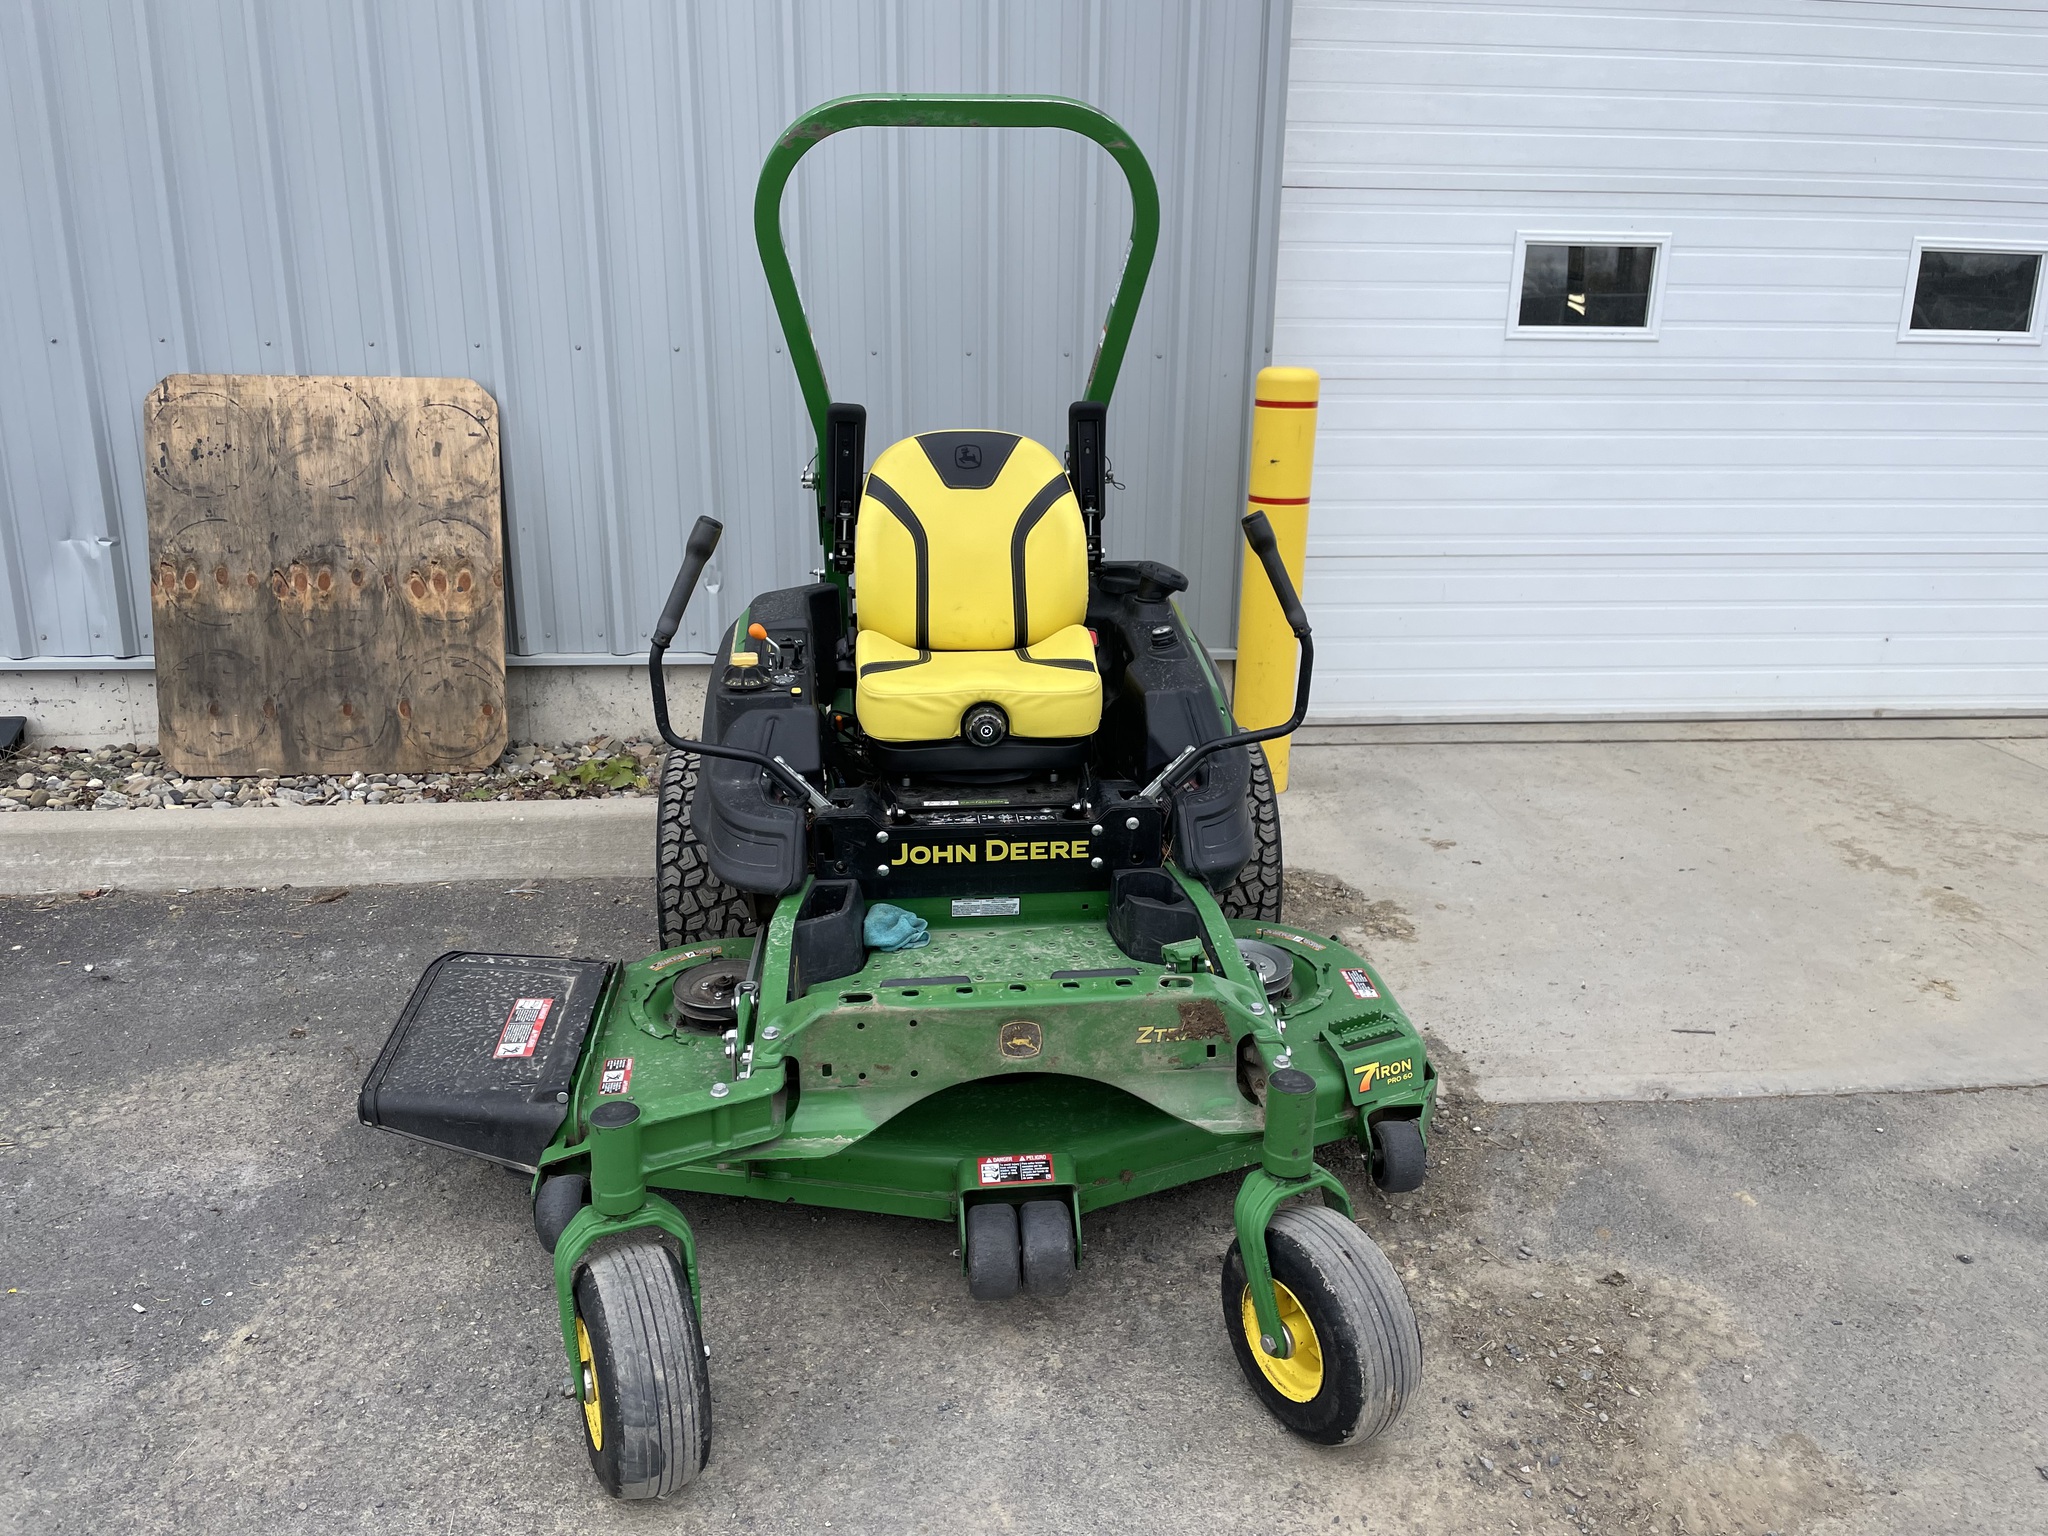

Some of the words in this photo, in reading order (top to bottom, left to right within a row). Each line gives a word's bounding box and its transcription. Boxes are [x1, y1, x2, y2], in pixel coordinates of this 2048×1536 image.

[891, 842, 977, 866] JOHN
[986, 839, 1090, 862] DEERE
[1387, 1075, 1402, 1085] PRO
[1402, 1072, 1413, 1080] 60
